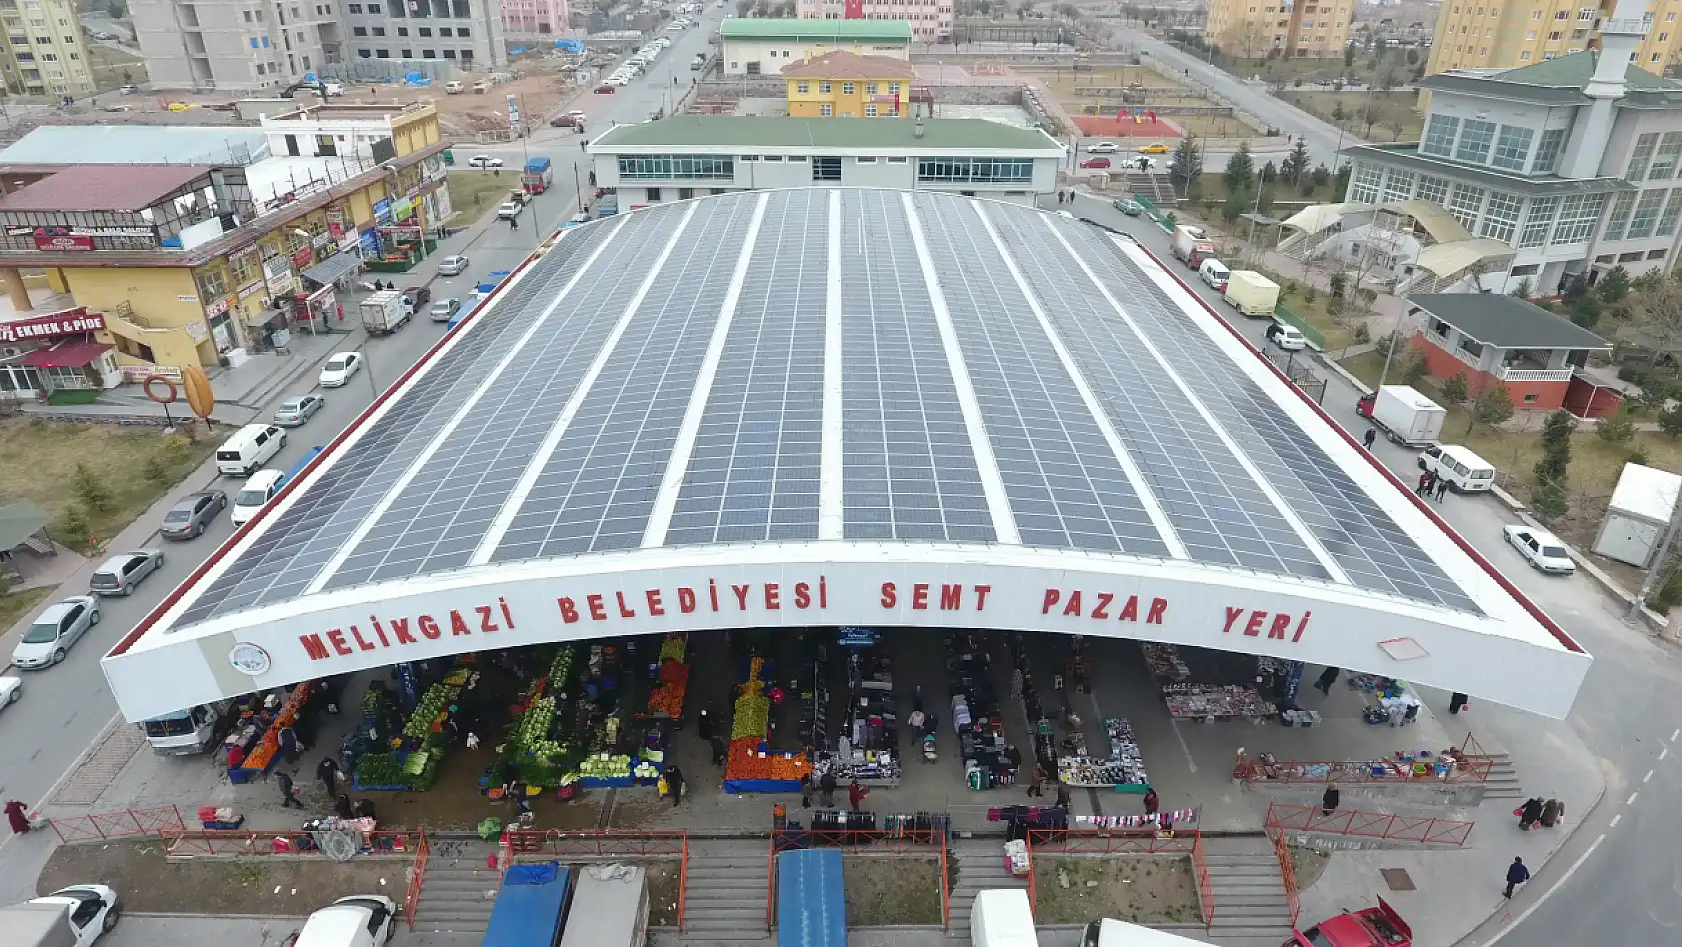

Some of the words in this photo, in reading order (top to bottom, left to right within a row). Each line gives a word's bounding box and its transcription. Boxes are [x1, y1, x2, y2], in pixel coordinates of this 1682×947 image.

[16, 322, 61, 338] EKMEK
[63, 321, 73, 332] &
[72, 316, 102, 331] PİDE
[299, 596, 515, 660] MELİKGAZİ
[558, 575, 828, 624] BELEDİYESİ
[881, 581, 991, 610] SEMT
[1042, 588, 1168, 624] PAZAR
[1223, 606, 1311, 642] YERİ
